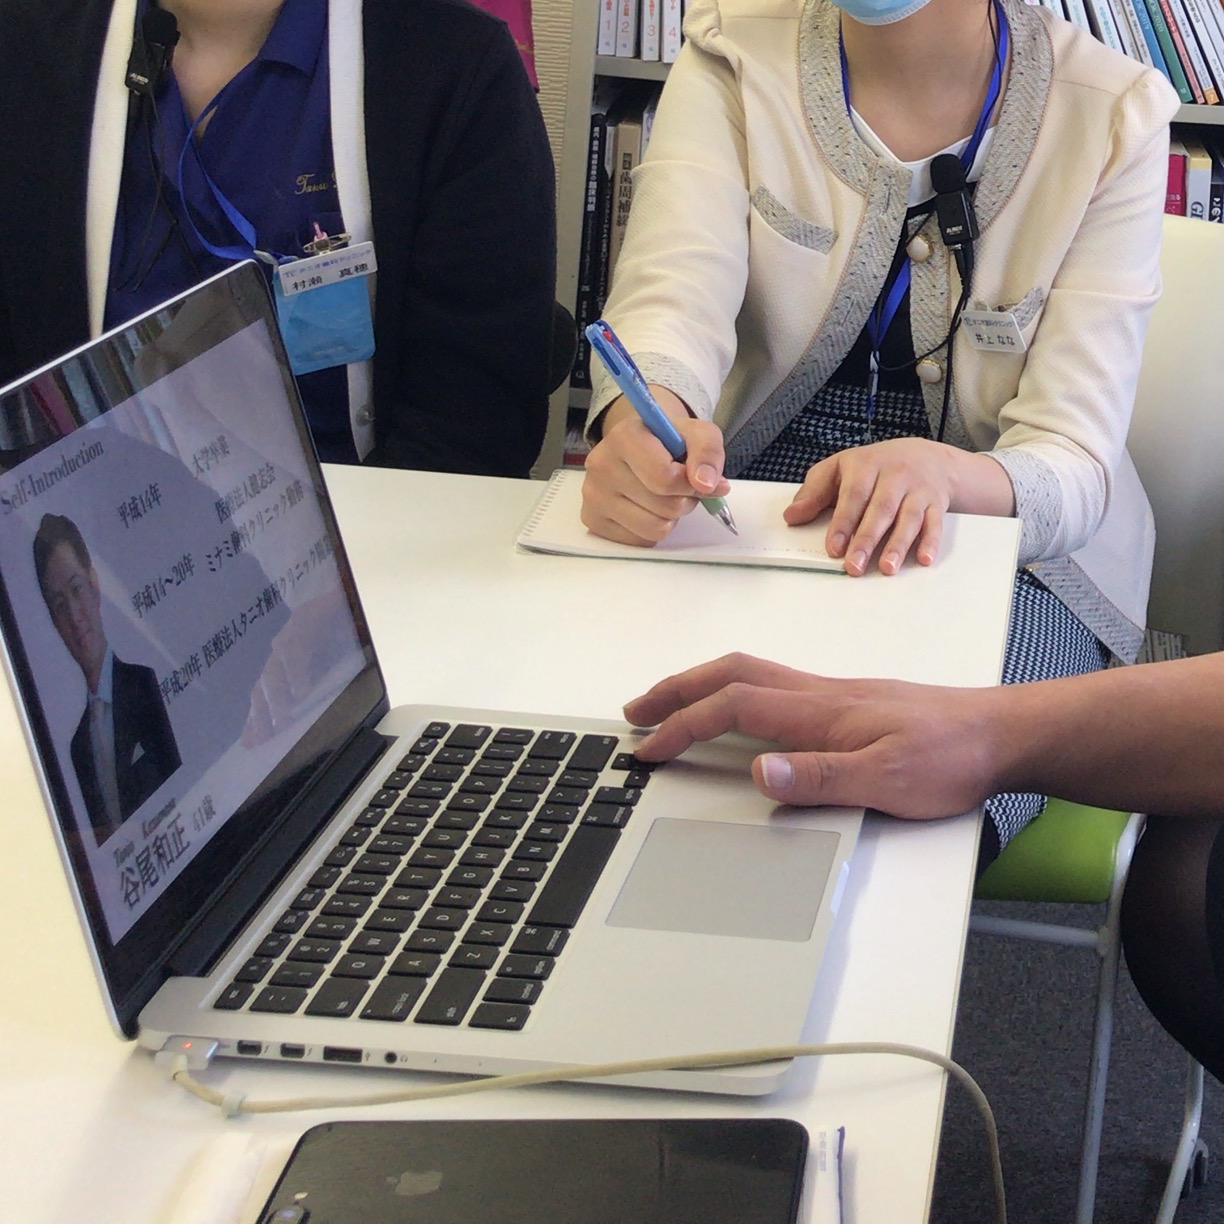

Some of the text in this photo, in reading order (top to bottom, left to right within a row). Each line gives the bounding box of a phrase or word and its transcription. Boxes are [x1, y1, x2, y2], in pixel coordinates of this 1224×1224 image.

[1, 440, 104, 516] Self-Introduction
[117, 482, 162, 528] 平成14年
[159, 651, 203, 706] 平成20年
[120, 812, 190, 911] 谷尾和正
